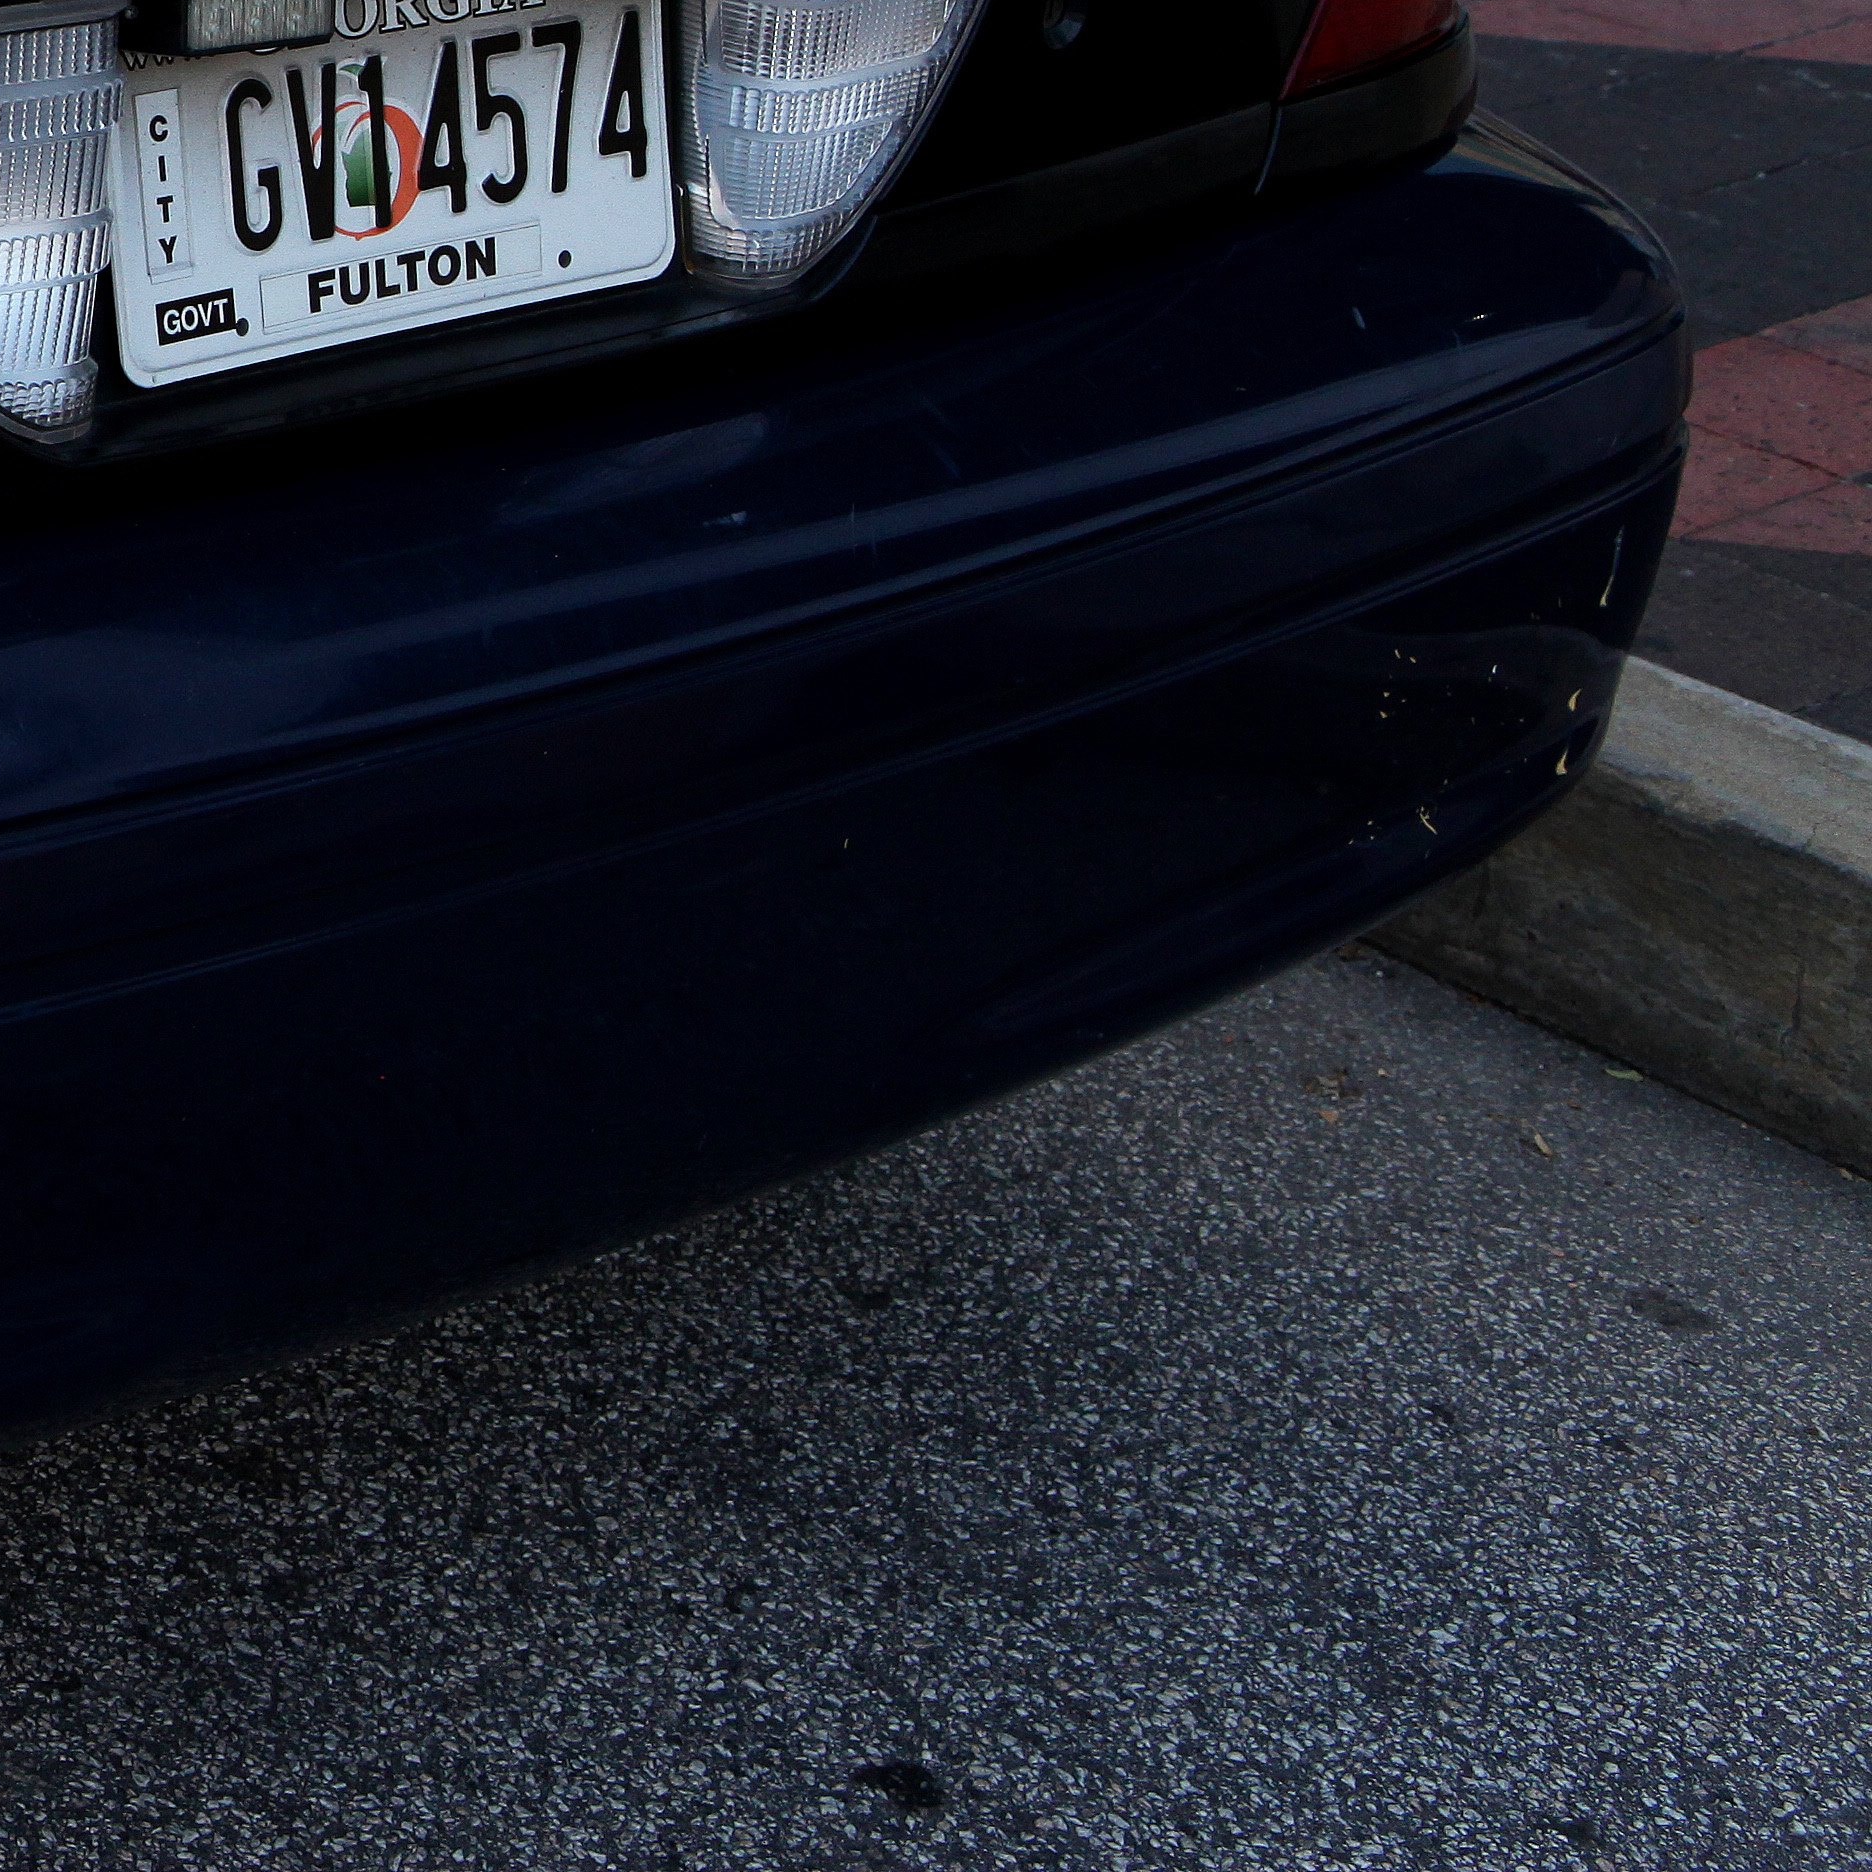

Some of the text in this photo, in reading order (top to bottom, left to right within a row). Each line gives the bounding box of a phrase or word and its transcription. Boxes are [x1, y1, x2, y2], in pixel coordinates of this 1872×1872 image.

[225, 5, 649, 252] GV14574
[148, 114, 179, 265] CITY
[162, 298, 228, 335] GOVT
[308, 236, 496, 315] FULTON
